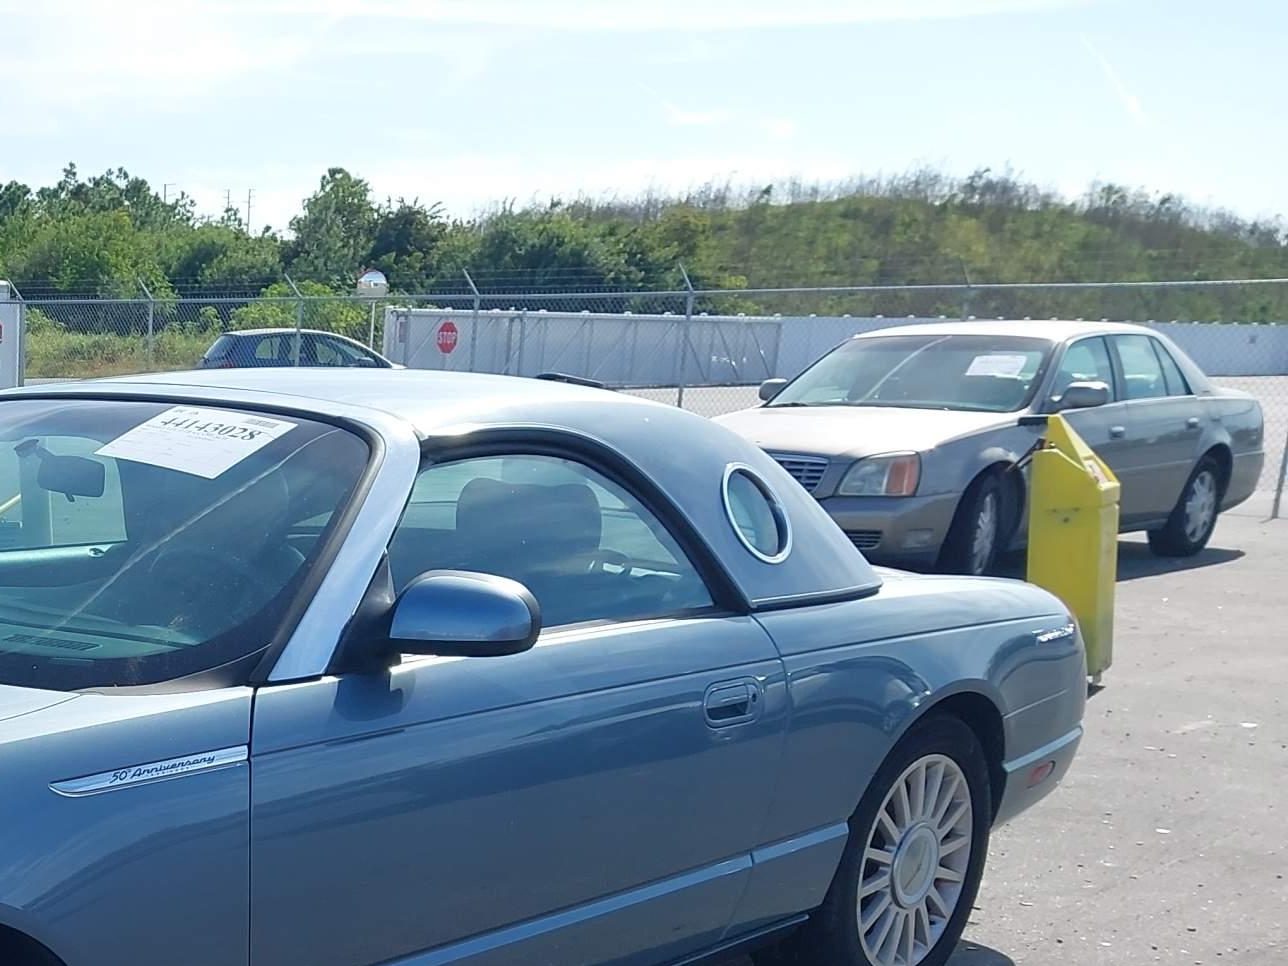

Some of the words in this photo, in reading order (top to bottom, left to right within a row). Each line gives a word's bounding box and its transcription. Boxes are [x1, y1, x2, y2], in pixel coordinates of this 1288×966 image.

[438, 331, 457, 344] STOP
[161, 417, 262, 441] 44143028
[130, 755, 215, 779] Anniversary
